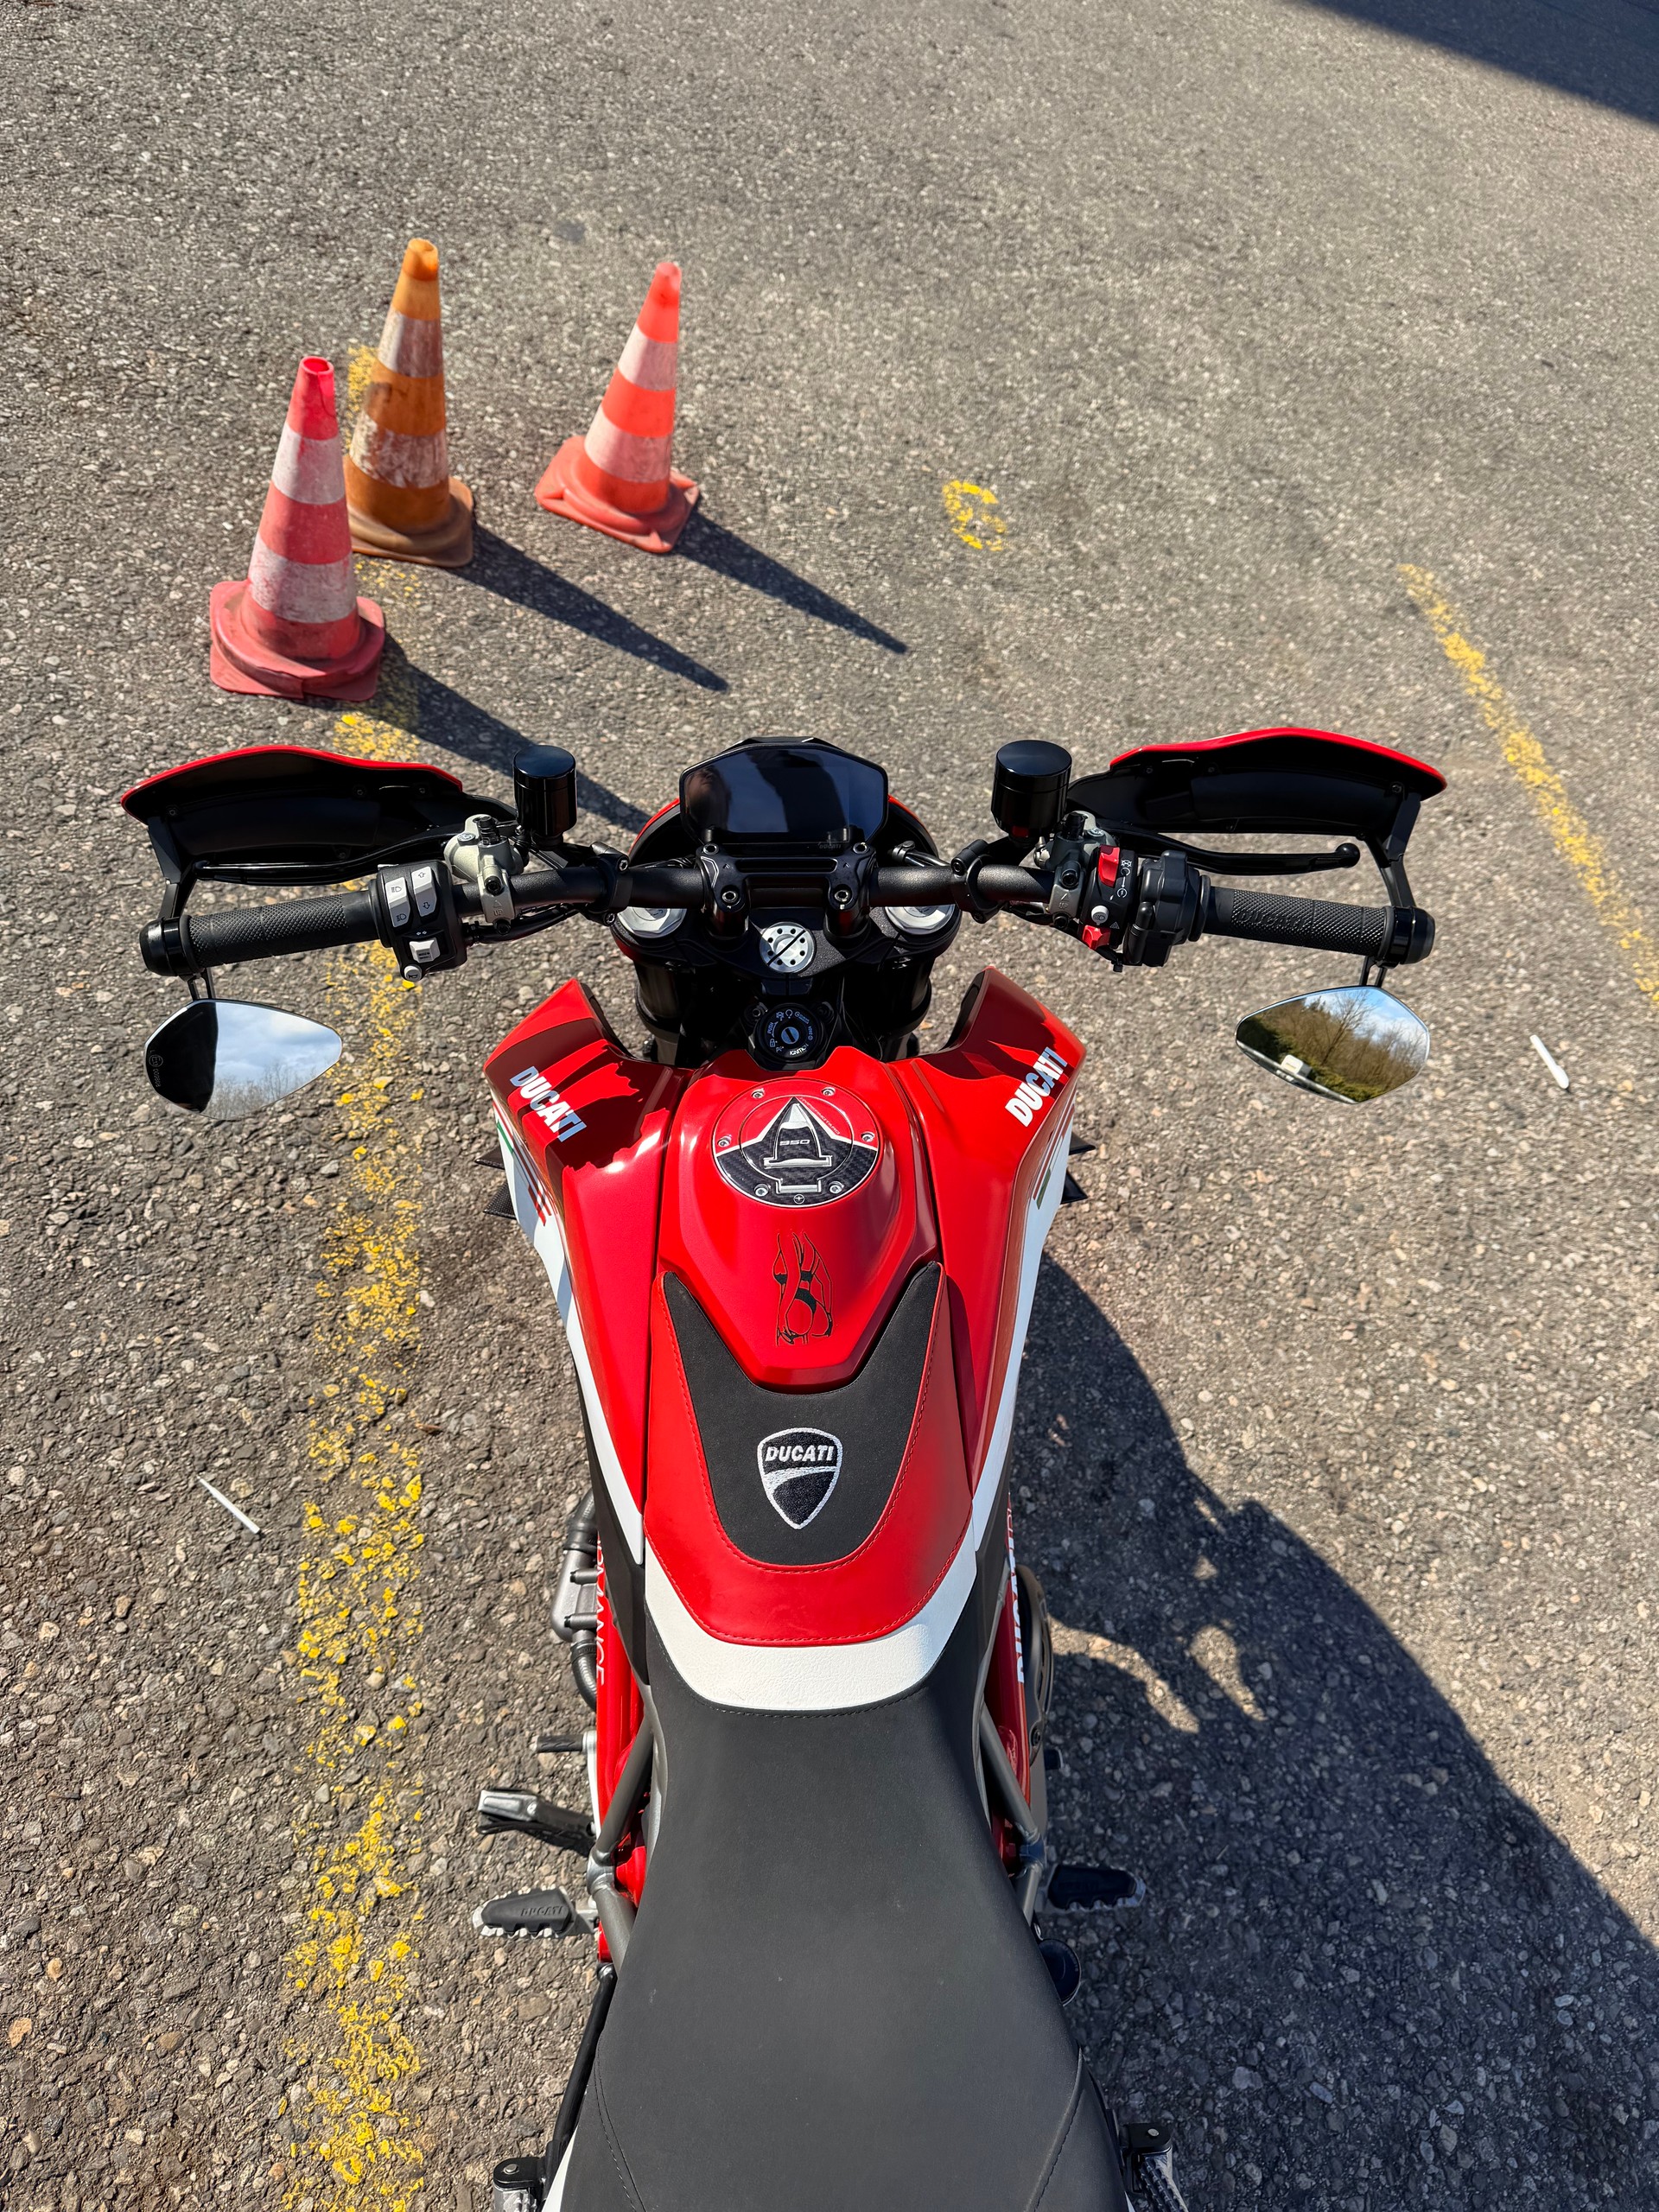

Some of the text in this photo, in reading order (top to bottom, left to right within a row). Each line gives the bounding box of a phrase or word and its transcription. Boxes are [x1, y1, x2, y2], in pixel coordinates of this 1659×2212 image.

[493, 908, 504, 917] UP
[1237, 911, 1306, 930] DUCATI
[1004, 1046, 1068, 1128] DUCATI
[509, 1065, 588, 1142] DUCATI
[765, 1445, 835, 1462] DUCATI
[520, 1905, 563, 1916] DUCATI
